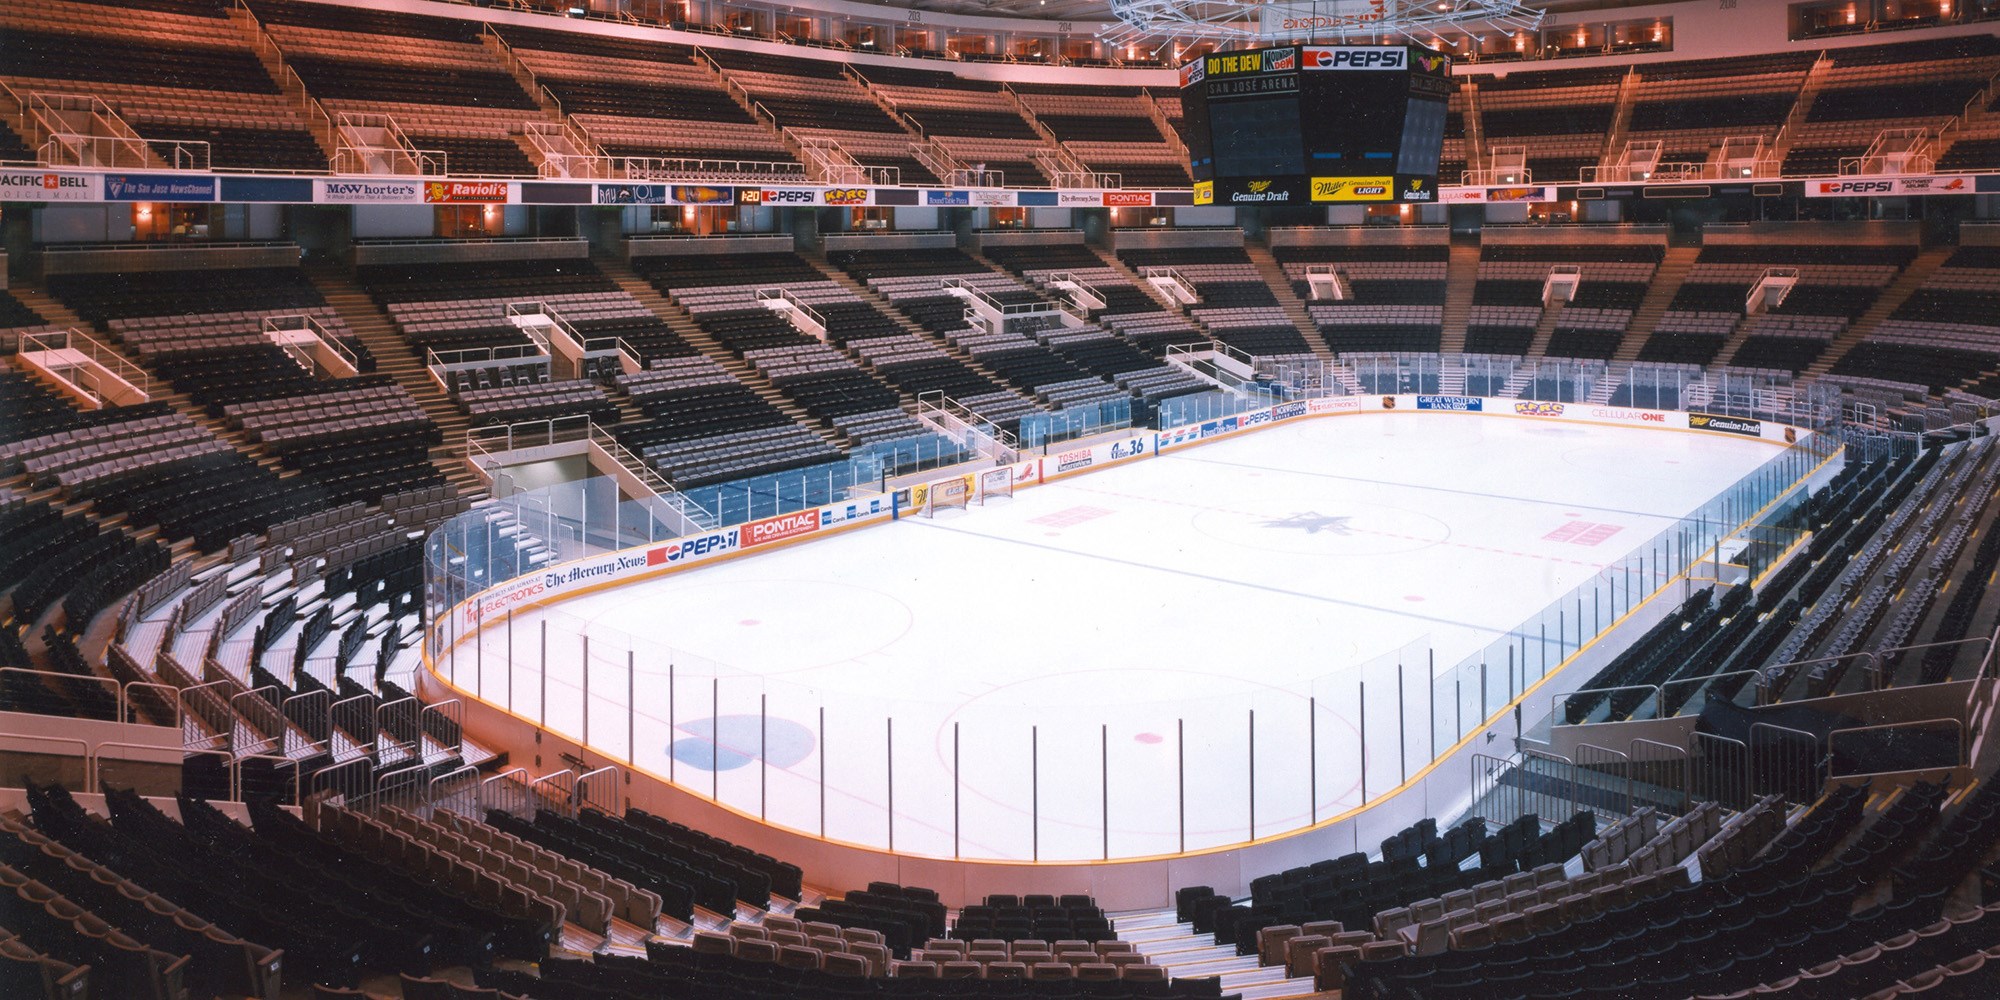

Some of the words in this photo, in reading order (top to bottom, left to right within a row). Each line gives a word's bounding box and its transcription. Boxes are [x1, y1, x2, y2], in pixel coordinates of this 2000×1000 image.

[908, 10, 921, 22] 203
[1543, 14, 1557, 26] 207
[1058, 22, 1072, 32] 204
[1208, 58, 1220, 75] DO
[1222, 56, 1238, 73] THE
[1240, 54, 1261, 71] DEW
[1332, 51, 1404, 67] PEPSI
[1209, 83, 1229, 94] SAN
[1233, 78, 1257, 93] JOSÉ
[1261, 77, 1296, 90] ARENA
[0, 174, 43, 186] ACIFIC
[60, 177, 88, 187] BELL
[1841, 181, 1893, 193] PEPSI
[4, 190, 41, 199] OICE
[52, 191, 88, 199] MAIL
[124, 183, 136, 193] The
[137, 183, 151, 194] San
[152, 184, 169, 194] Jose
[170, 184, 213, 195] NewsChannel
[452, 183, 507, 195] Ravioli's
[1313, 181, 1347, 196] Miller
[599, 188, 616, 204] BAY
[777, 190, 815, 202] PEPSI
[824, 188, 867, 203] KFRC
[1061, 194, 1070, 202] The
[1071, 195, 1088, 203] Mercury
[1109, 194, 1150, 202] PONTIAC
[1232, 192, 1266, 202] Genuine
[1267, 190, 1289, 201] Draft
[1322, 402, 1359, 410] ELECTRONICS
[1444, 396, 1480, 405] WESTERN
[1515, 402, 1564, 414] KFRC
[1249, 410, 1272, 425] PEPSI
[1710, 419, 1741, 430] Genuine
[1741, 422, 1761, 433] Draft
[1129, 437, 1144, 456] 36
[1058, 448, 1092, 464] TOSHIBA
[753, 512, 815, 538] PONTIAC
[680, 530, 738, 559] PEPSI
[545, 572, 566, 588] The
[568, 562, 615, 583] Mercury
[616, 555, 646, 572] News
[485, 582, 545, 613] ELECTRONICS
